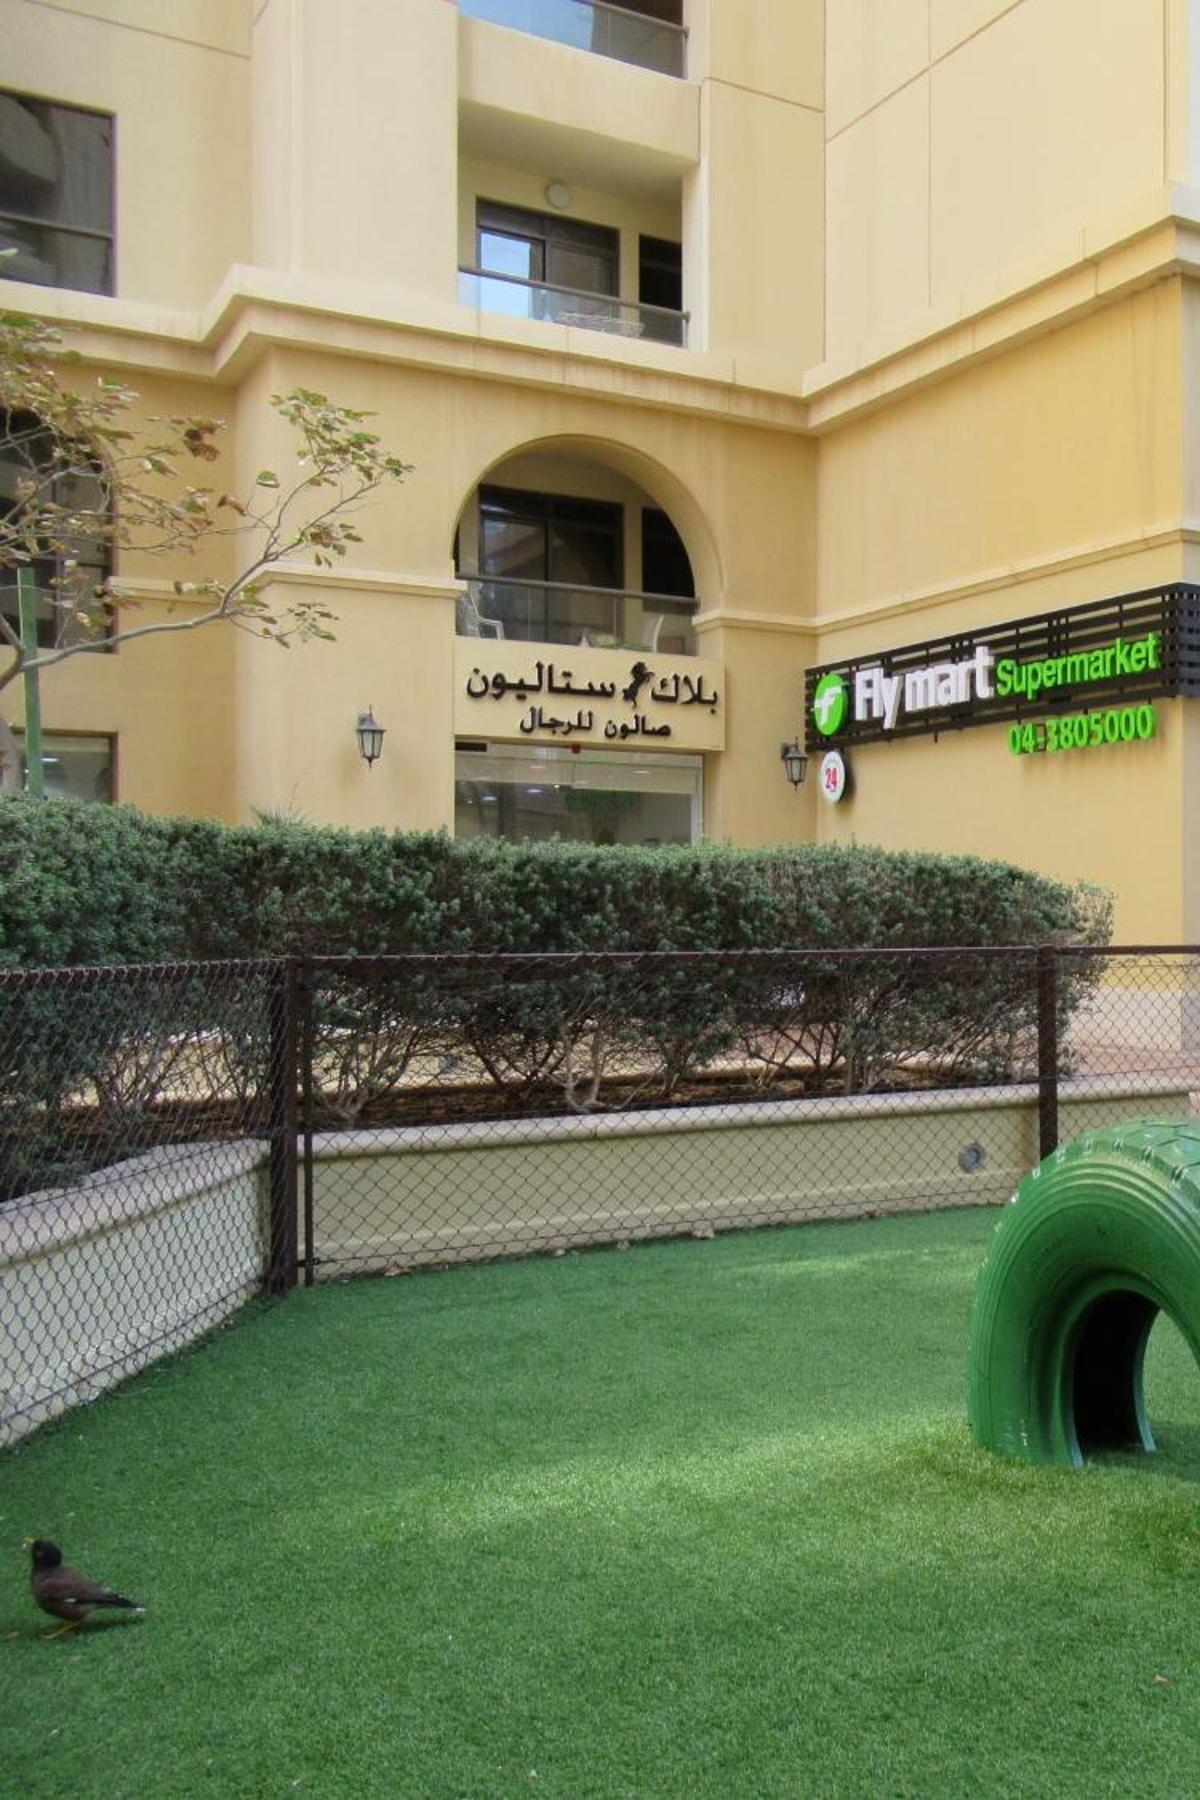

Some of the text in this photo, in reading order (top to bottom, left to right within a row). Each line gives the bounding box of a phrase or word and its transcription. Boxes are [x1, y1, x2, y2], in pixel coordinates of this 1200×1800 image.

[466, 660, 718, 715] بلاك ستاليون
[854, 631, 1161, 730] Fly mart Supermarket
[519, 706, 673, 740] صالون للرجال
[825, 767, 838, 791] 24
